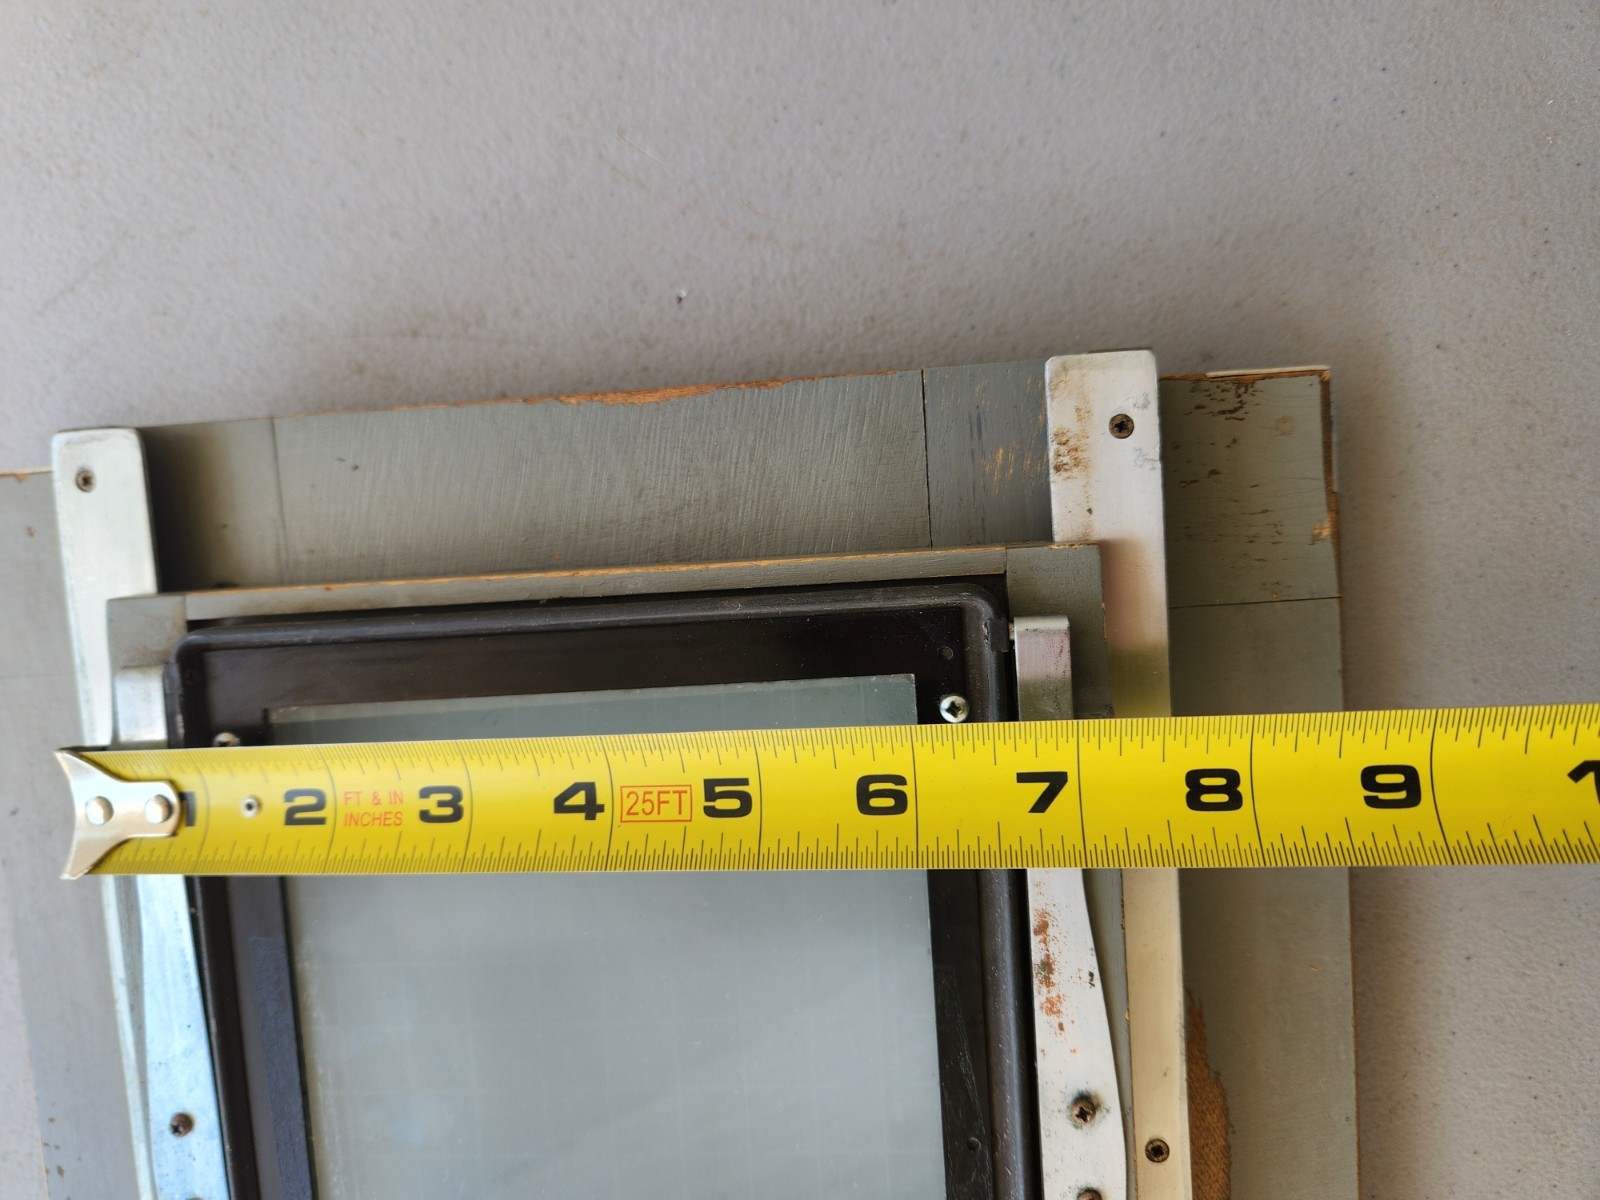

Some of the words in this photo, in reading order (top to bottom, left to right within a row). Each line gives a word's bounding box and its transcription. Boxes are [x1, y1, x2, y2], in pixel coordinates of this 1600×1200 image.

[343, 791, 364, 806] FT
[372, 790, 382, 806] &
[388, 790, 404, 805] IN
[419, 785, 463, 824] 3
[553, 782, 604, 820] 4
[625, 790, 687, 816] 25FT
[703, 778, 752, 818] 5
[856, 774, 908, 816] 6
[1016, 771, 1068, 813] 7
[1185, 768, 1243, 811] 8
[1360, 764, 1421, 808] 9
[179, 791, 197, 827] 1
[284, 789, 327, 825] 2
[343, 811, 403, 827] INCHES
